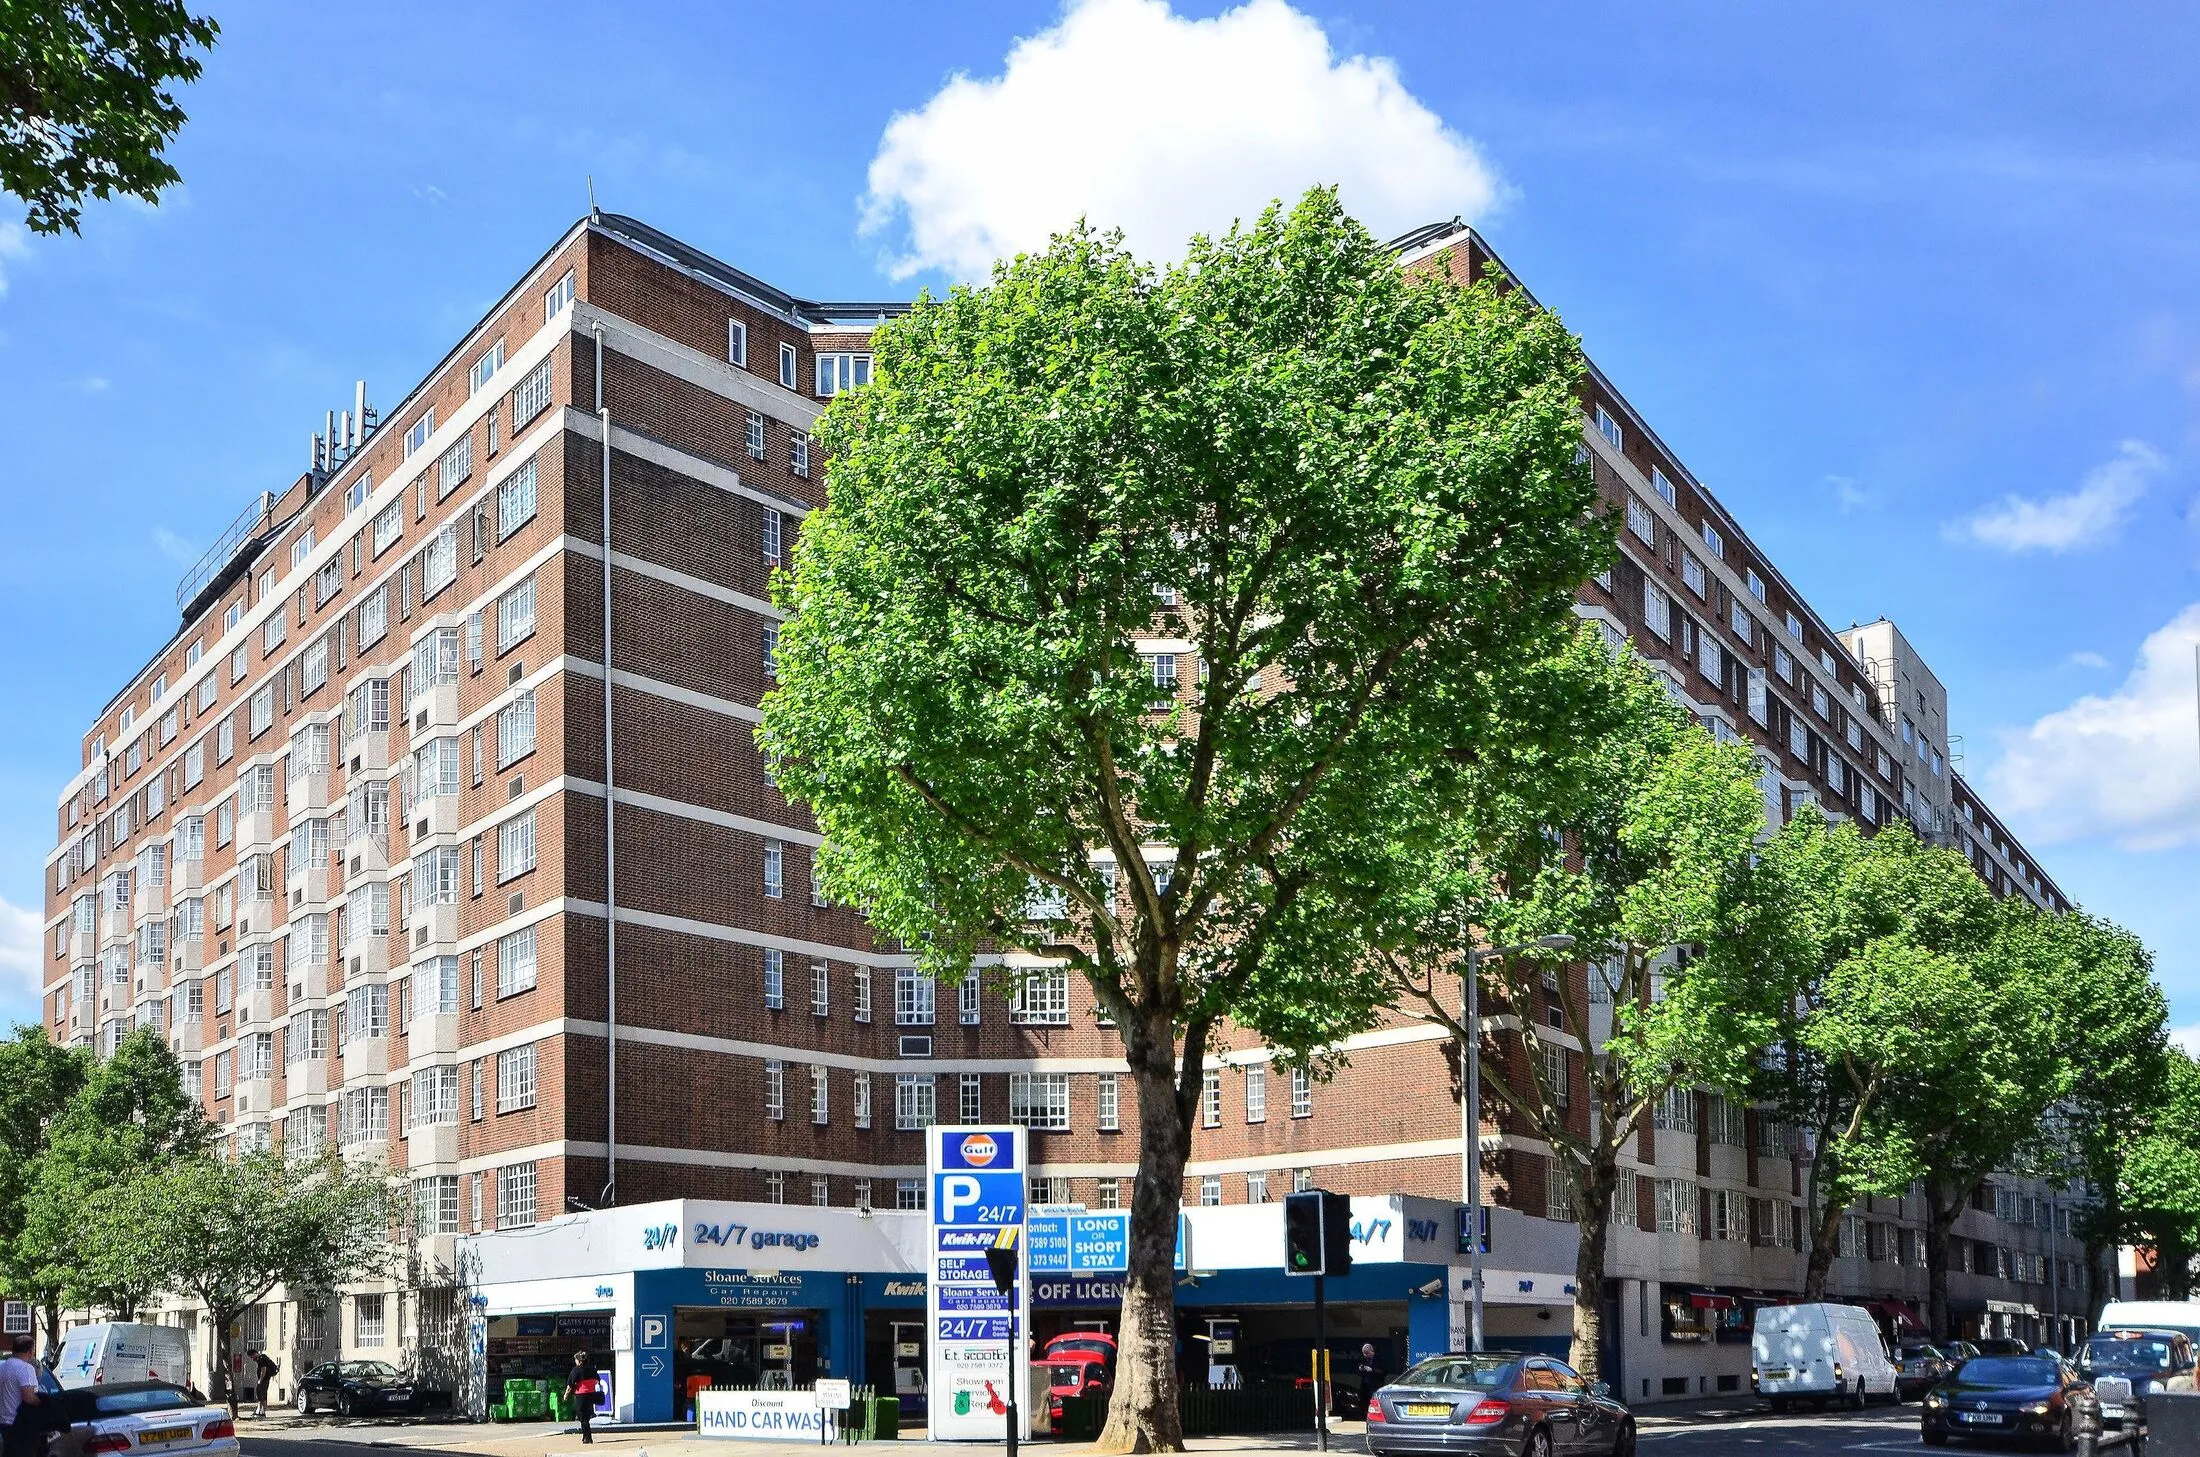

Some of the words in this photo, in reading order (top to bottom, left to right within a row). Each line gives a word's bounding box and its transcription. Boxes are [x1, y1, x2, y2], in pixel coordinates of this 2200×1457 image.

[964, 1145, 994, 1154] Gulf
[943, 1175, 981, 1222] P
[978, 1205, 1017, 1222] 24/7
[1028, 1222, 1058, 1233] ontact:
[1077, 1219, 1118, 1231] LONG
[644, 1223, 678, 1251] 24/7
[695, 1223, 748, 1246] 24/7
[751, 1231, 820, 1251] garage
[1091, 1232, 1105, 1240] OR
[1350, 1218, 1392, 1245] 4/7
[1030, 1237, 1048, 1249] 7589
[1050, 1237, 1067, 1249] 5100
[1075, 1241, 1122, 1253] SHORT
[940, 1259, 966, 1269] SELF
[1033, 1254, 1047, 1266] 373
[1048, 1254, 1067, 1265] 9447
[1082, 1255, 1116, 1266] STAY
[705, 1271, 747, 1283] Sloane
[940, 1270, 990, 1279] STORAGE
[710, 1288, 734, 1296] Car
[743, 1288, 799, 1297] Repairs
[884, 1282, 927, 1296] Kwik-
[943, 1288, 973, 1297] Sloane
[1038, 1283, 1071, 1300] OFF
[1076, 1282, 1124, 1300] LICEN
[720, 1297, 738, 1305] 020
[741, 1297, 762, 1305] 7589
[644, 1320, 663, 1344] P
[940, 1319, 988, 1338] 24/7
[751, 1398, 784, 1408] Discount
[703, 1410, 747, 1428] HAND
[751, 1411, 783, 1429] CAR
